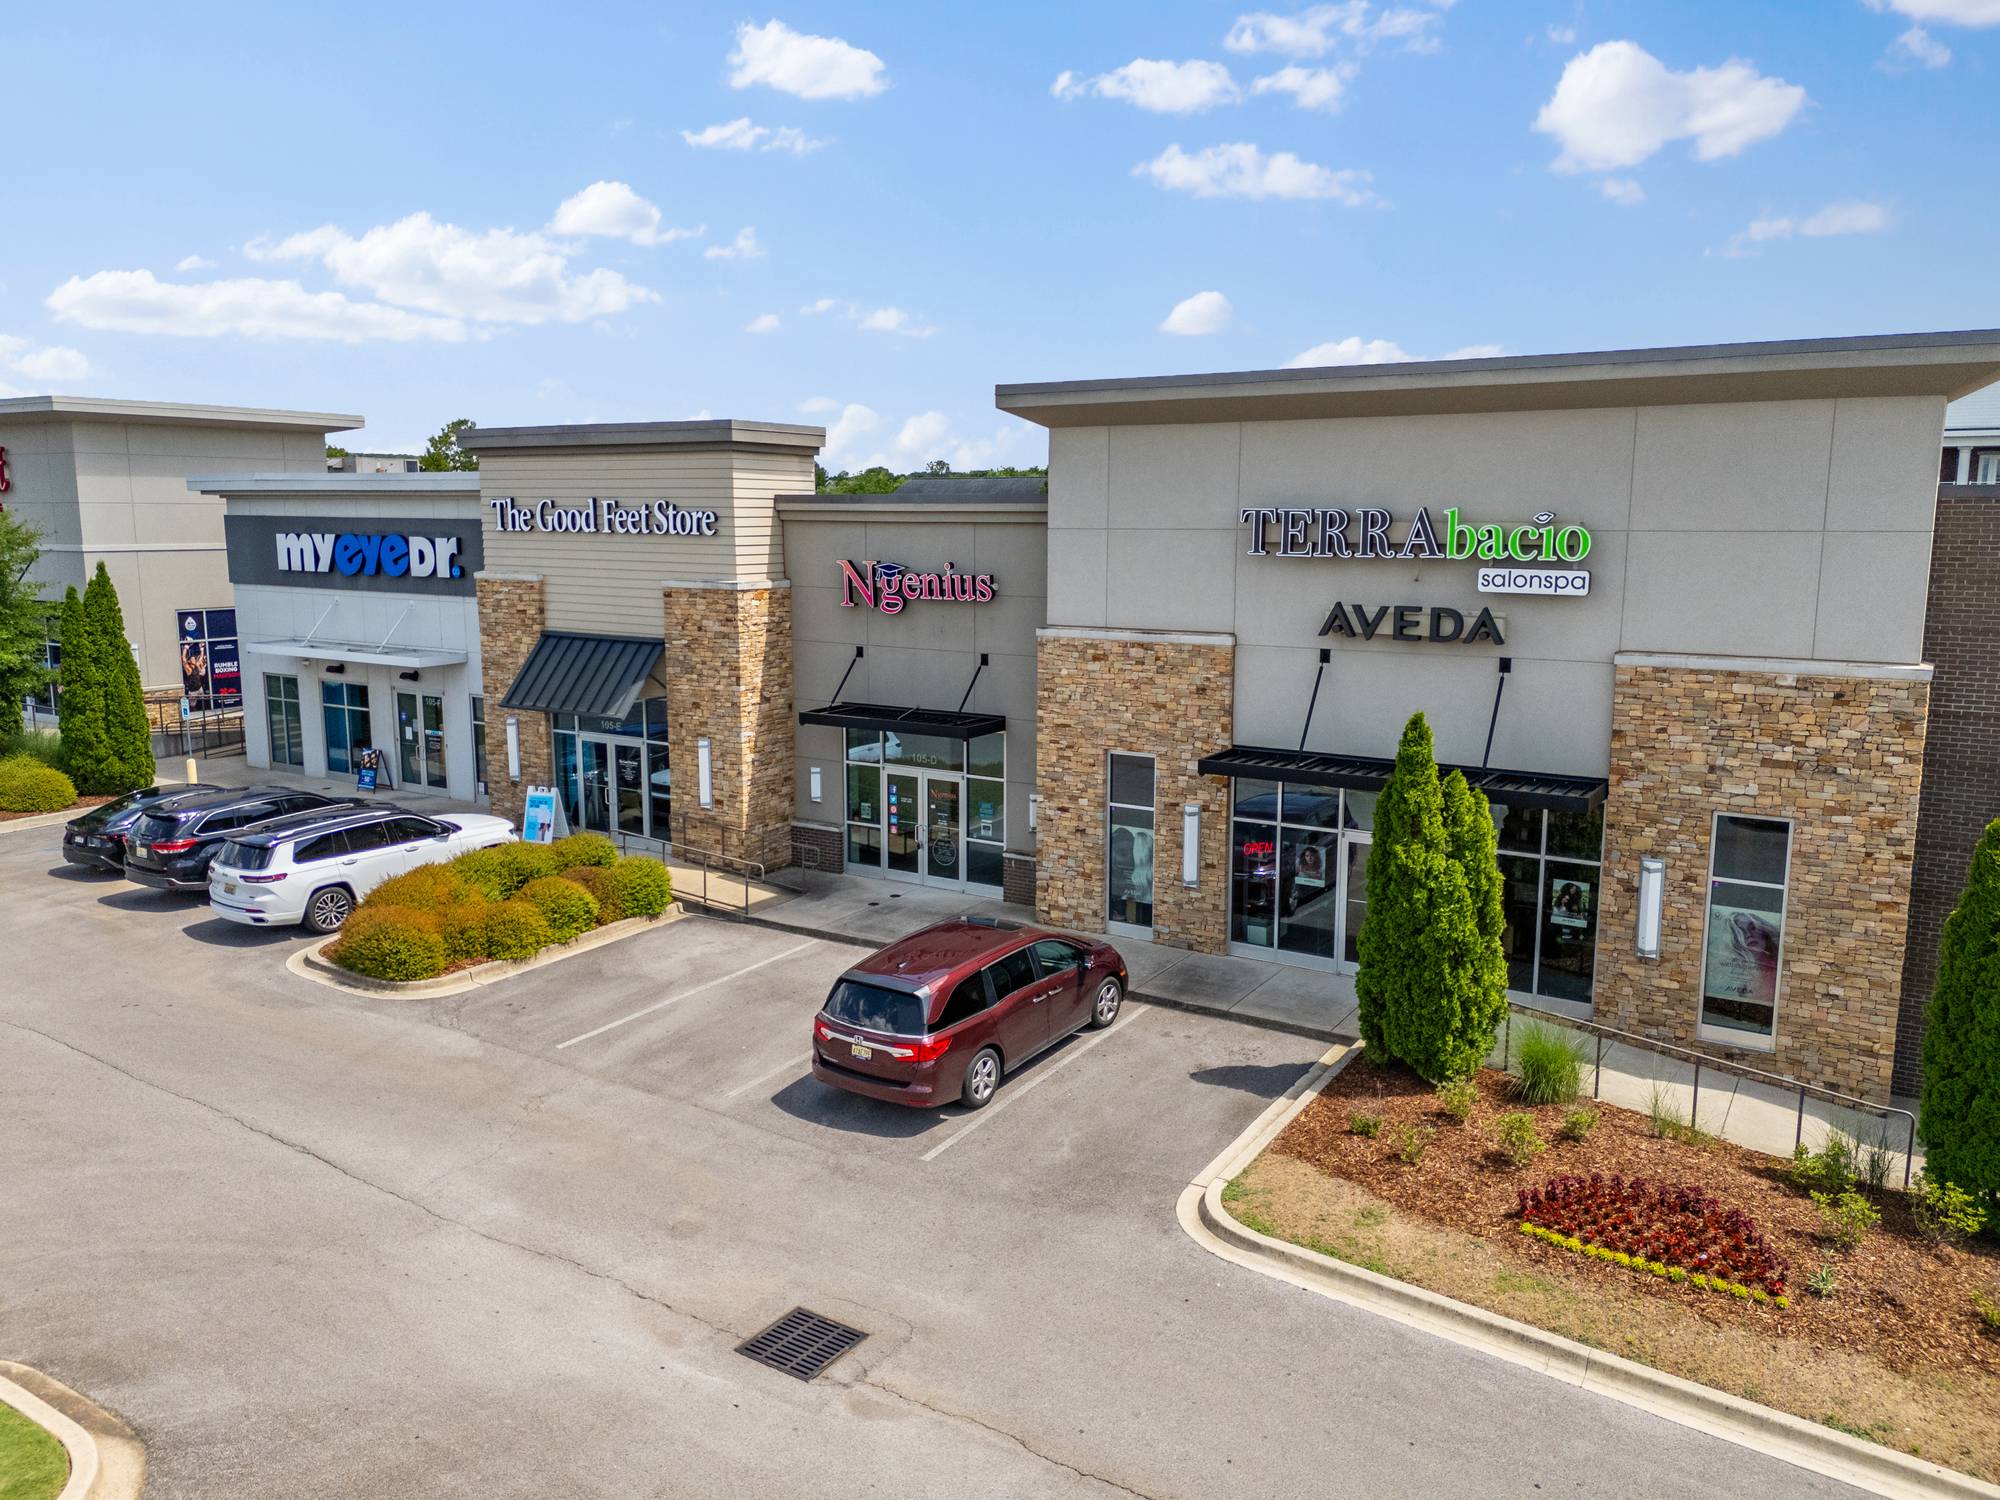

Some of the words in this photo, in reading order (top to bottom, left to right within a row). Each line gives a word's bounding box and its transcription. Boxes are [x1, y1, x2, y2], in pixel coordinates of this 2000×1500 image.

[490, 498, 533, 532] The
[536, 498, 598, 533] Good
[601, 500, 651, 534] Feet
[653, 500, 718, 536] Store
[1480, 571, 1587, 593] salonspa
[1318, 601, 1506, 646] AVEDA
[214, 666, 238, 674] BOXING
[912, 753, 937, 765] 105-D
[1243, 840, 1274, 856] OPEN
